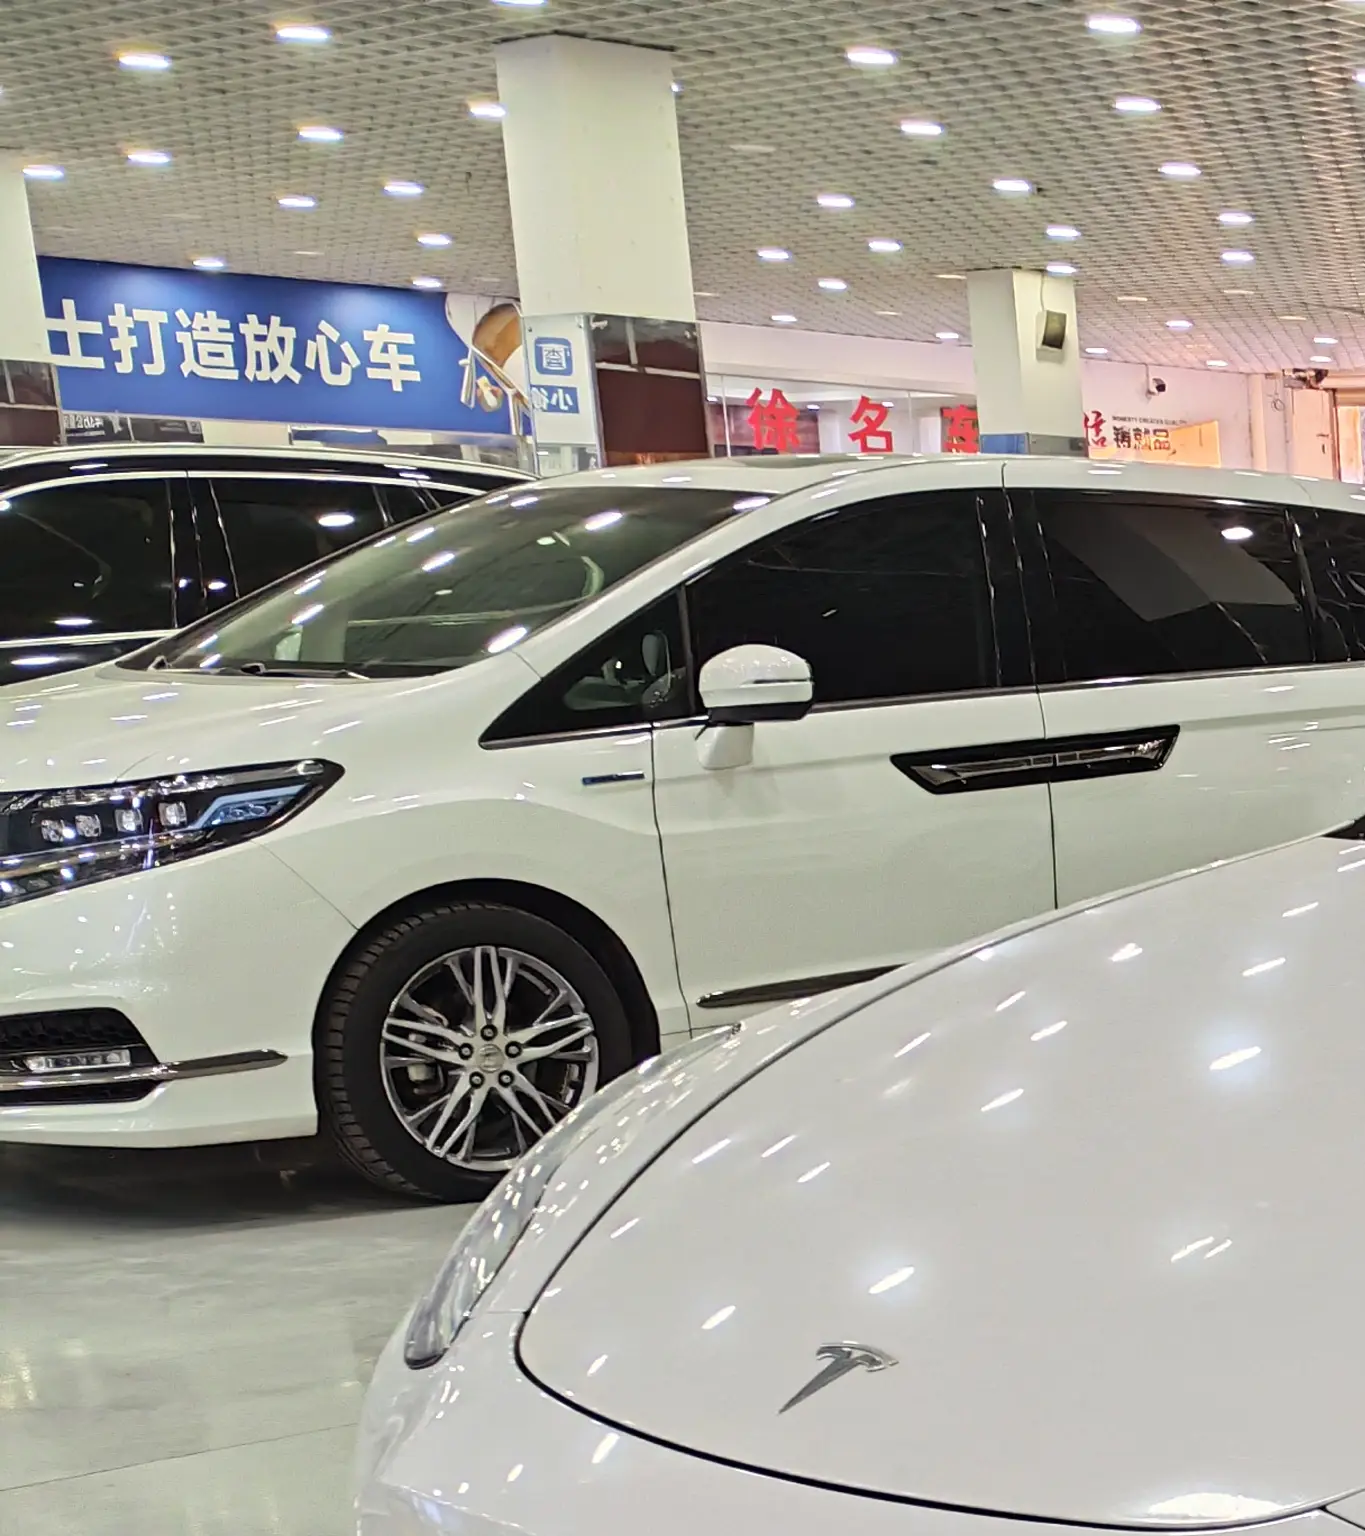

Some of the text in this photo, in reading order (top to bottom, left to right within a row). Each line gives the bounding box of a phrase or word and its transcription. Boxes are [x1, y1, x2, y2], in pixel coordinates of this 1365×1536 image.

[45, 298, 421, 392] 士打造放心车
